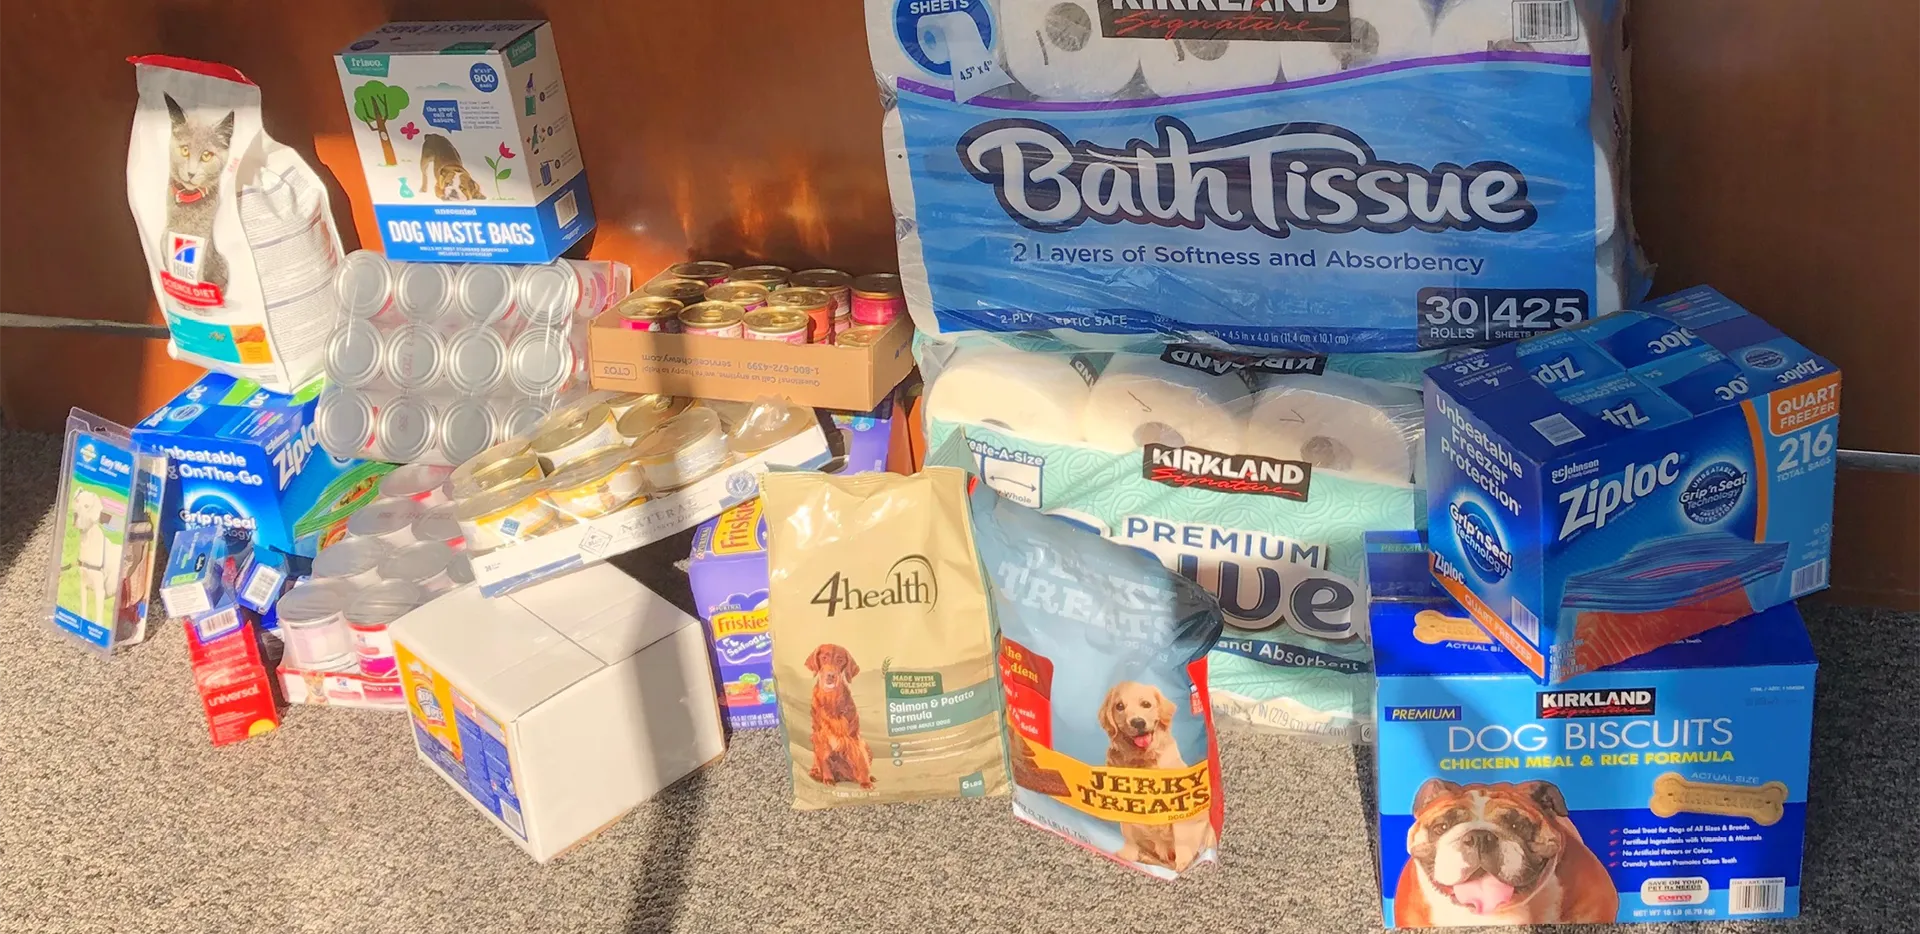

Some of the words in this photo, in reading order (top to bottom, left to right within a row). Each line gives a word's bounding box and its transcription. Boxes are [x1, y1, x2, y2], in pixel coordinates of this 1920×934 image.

[909, 0, 971, 15] SHEETS
[387, 219, 424, 243] DOG
[424, 221, 487, 245] WASTE
[487, 221, 535, 246] BAGS
[1013, 243, 1027, 262] 2
[1036, 244, 1115, 265] Layers
[1121, 243, 1146, 263] of
[1153, 243, 1261, 267] Softness
[1268, 247, 1317, 269] and
[1325, 248, 1485, 276] Absorbency
[193, 287, 216, 298] DIET
[1000, 312, 1034, 325] 2-PLY
[1094, 314, 1128, 327] SAFE
[1424, 295, 1479, 326] 30
[1491, 297, 1582, 328] 425
[1430, 327, 1475, 339] ROLLS
[1494, 330, 1533, 339] SHEETS
[1454, 357, 1490, 375] 216
[1776, 359, 1825, 385] Ziploc
[1775, 384, 1838, 416] QUART
[1779, 402, 1836, 430] FREEZER
[1435, 394, 1523, 480] Unbeatable
[1775, 425, 1835, 473] 216
[1152, 448, 1305, 485] KIRKLAND
[1451, 426, 1510, 487] Freezer
[179, 463, 263, 487] On-The-Go
[1691, 465, 1736, 488] UNBEATABLE
[1776, 466, 1806, 482] TOTAL
[1807, 456, 1832, 476] BAGS
[1150, 466, 1302, 497] Signature
[1717, 473, 1747, 492] Seal
[1558, 452, 1681, 542] Ziploc
[1687, 488, 1740, 509] Technology
[223, 513, 257, 530] Seal
[1126, 517, 1319, 569] PREMIUM
[1456, 524, 1508, 580] Technology
[1484, 538, 1514, 571] Seal
[1433, 550, 1466, 586] Ziploc
[810, 570, 932, 618] 4health
[1464, 594, 1496, 628] QUART
[1496, 621, 1533, 665] FREEZER
[1217, 640, 1253, 655] and
[1257, 643, 1360, 672] Absorbent
[1445, 641, 1489, 652] ACTUAL
[208, 683, 261, 707] universal
[889, 701, 929, 714] Salmon
[930, 698, 939, 708] &
[940, 690, 975, 707] Potato
[1542, 691, 1652, 707] KIRKLAND
[890, 711, 933, 725] Formula
[1391, 709, 1456, 719] PREMIUM
[1541, 705, 1652, 719] Signature
[1449, 723, 1547, 752] DOG
[1565, 717, 1734, 750] BISCUITS
[1439, 756, 1520, 771] CHICKEN
[1526, 755, 1575, 768] MEAL
[1579, 754, 1595, 767] &
[1600, 752, 1640, 766] RICE
[1644, 750, 1735, 764] FORMULA
[961, 780, 970, 790] 5
[1089, 767, 1208, 796] JERKY
[1690, 771, 1734, 784] ACTUAL
[1735, 776, 1760, 785] SIZE
[1076, 786, 1210, 815] TREATS
[1622, 827, 1641, 835] Good
[1658, 826, 1668, 834] for
[1669, 826, 1685, 835] Dogs
[1686, 825, 1693, 833] of
[1622, 837, 1649, 846] Fortified
[1649, 837, 1684, 846] Ingredients
[1685, 836, 1699, 844] with
[1735, 834, 1762, 842] Minerals
[1622, 860, 1648, 869] Crunchy
[1633, 848, 1660, 857] Artificial
[1657, 894, 1693, 903] COSTCO
[1632, 909, 1648, 917] NET
